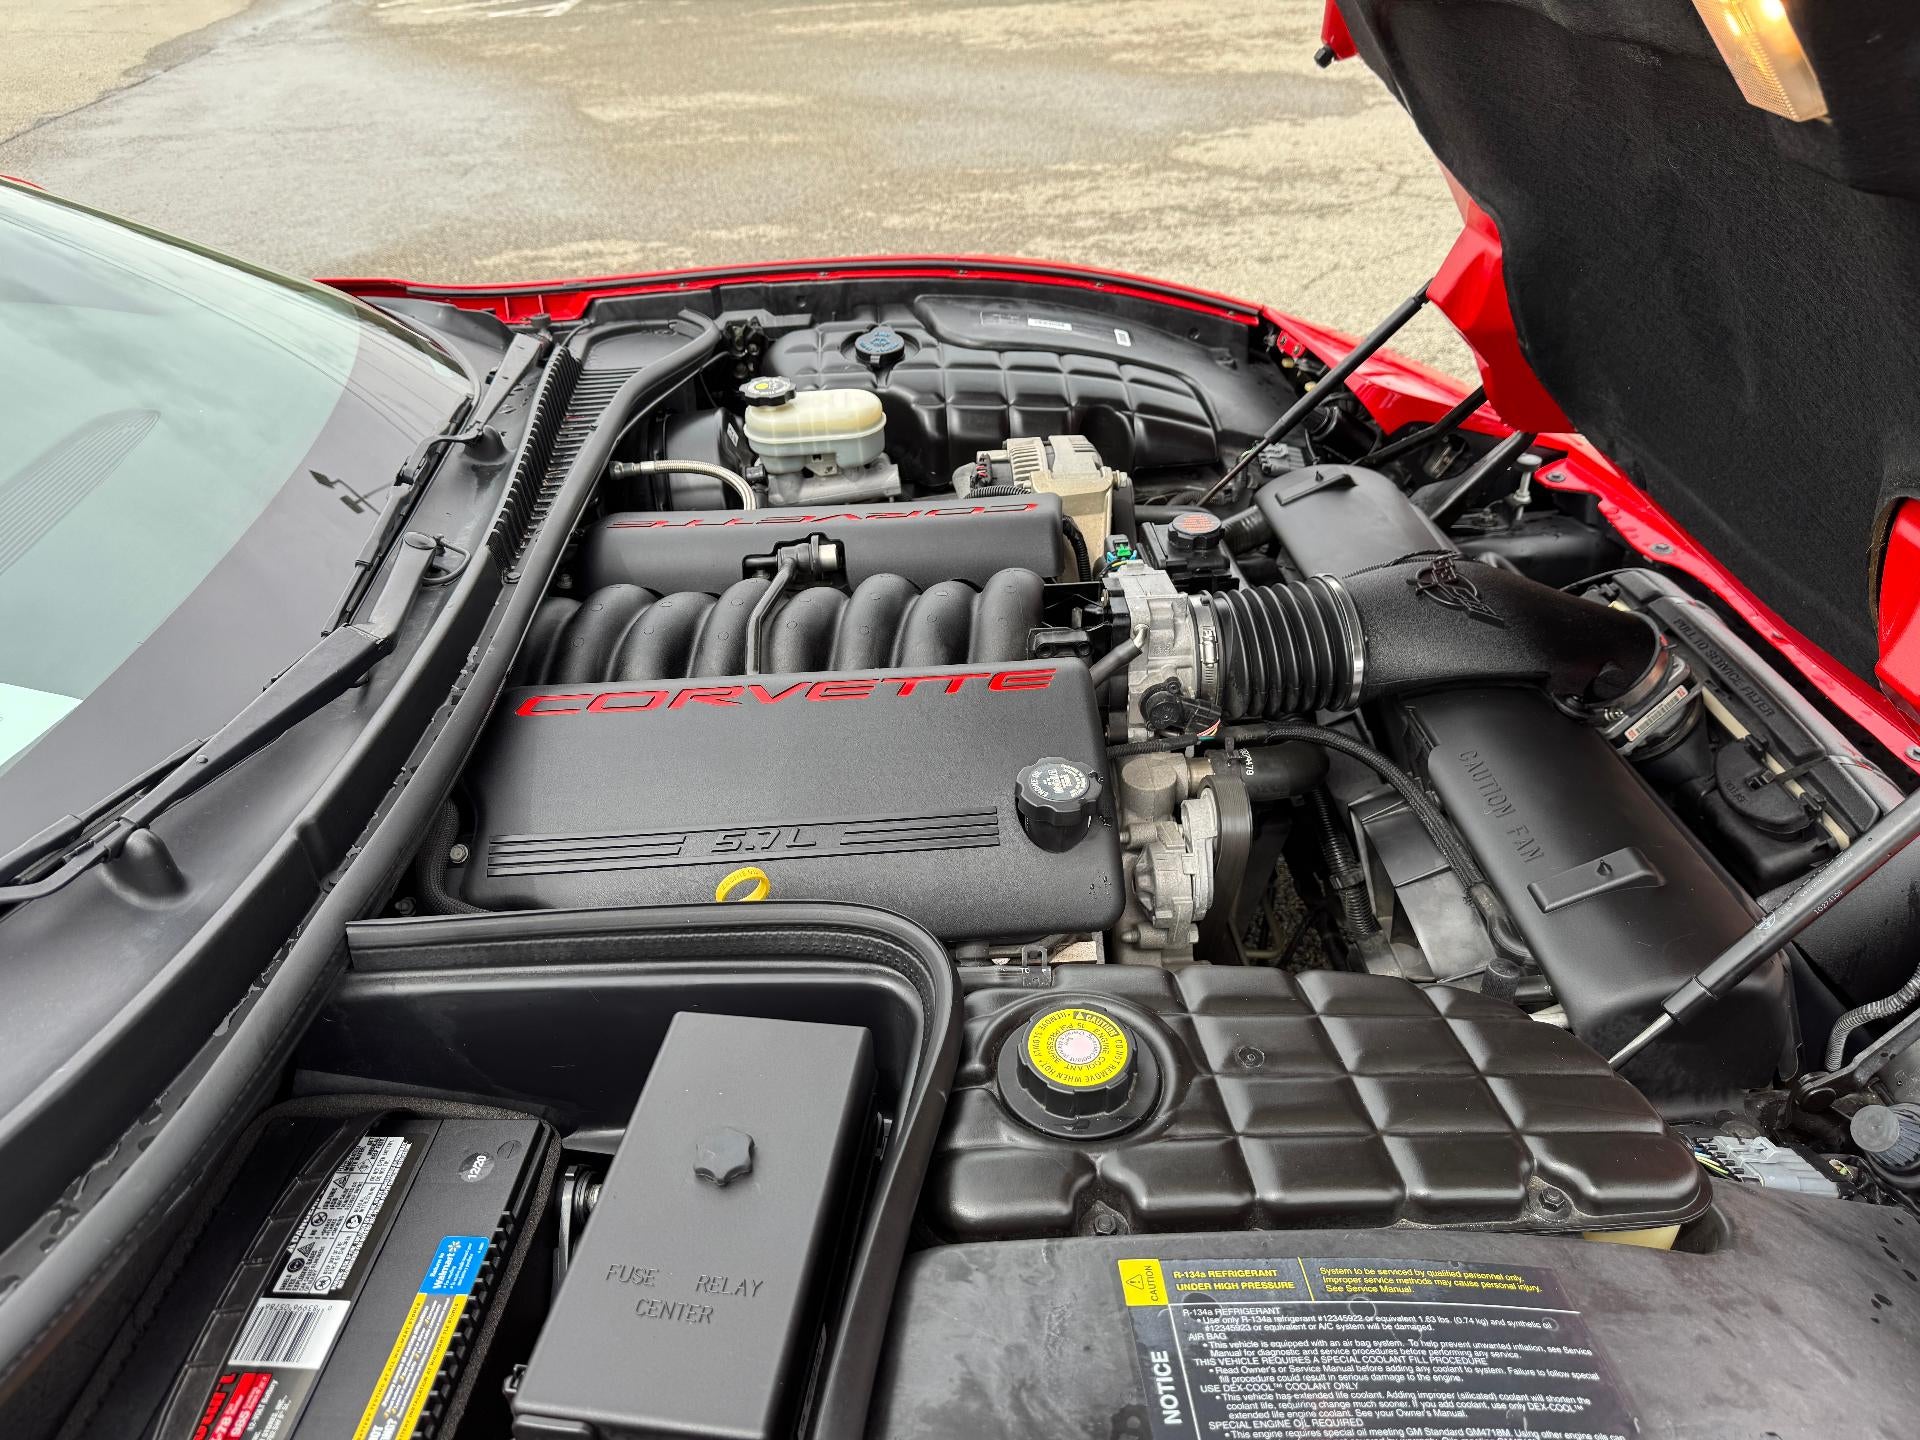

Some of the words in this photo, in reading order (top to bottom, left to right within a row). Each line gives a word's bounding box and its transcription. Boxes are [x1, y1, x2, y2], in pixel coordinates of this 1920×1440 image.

[606, 502, 1039, 529] CORVETTE
[1694, 637, 1708, 650] TO
[1706, 649, 1742, 687] SERVICE
[1741, 686, 1776, 717] FILTER
[515, 667, 1057, 717] CORVETTE
[1458, 750, 1517, 819] CAUTION
[1506, 824, 1545, 863] FAN
[710, 827, 818, 854] 5.7L
[1040, 1011, 1067, 1031] REMOVE
[1085, 1013, 1120, 1038] CAUTION
[1032, 1031, 1043, 1057] SLOWLY
[1093, 1028, 1110, 1055] ENGINE
[1115, 1039, 1124, 1049] DO
[1064, 1056, 1106, 1072] COOLANT
[1114, 1050, 1124, 1064] NOT
[1039, 1060, 1056, 1076] HOT
[1085, 1063, 1117, 1082] REMOVE
[1056, 1072, 1082, 1083] WHEN
[467, 1155, 487, 1180] 12/20
[432, 1252, 456, 1289] Walmart
[1173, 1270, 1206, 1278] R-134a
[1207, 1269, 1278, 1277] REFRIGERANT
[1320, 1268, 1353, 1276] System
[1413, 1270, 1426, 1278] by
[1426, 1270, 1462, 1278] qualified
[1462, 1272, 1504, 1280] personnel
[605, 1263, 660, 1288] FUSE
[695, 1273, 764, 1298] RELAY
[1144, 1265, 1158, 1302] CAUTION
[1176, 1282, 1212, 1290] UNDER
[1240, 1281, 1295, 1289] PRESSURE
[1323, 1277, 1362, 1285] Improper
[1433, 1279, 1453, 1287] may
[1480, 1282, 1517, 1290] personal
[1345, 1284, 1378, 1292] Service
[635, 1298, 715, 1325] CENTER
[1182, 1308, 1213, 1316] R-134a
[1213, 1307, 1282, 1315] REFRIGERANT
[1202, 1316, 1220, 1324] Use
[1220, 1317, 1240, 1325] only
[1272, 1316, 1317, 1324] refrigerant
[1374, 1316, 1417, 1324] equivalent
[1489, 1318, 1506, 1326] and
[1506, 1320, 1541, 1328] synthetic
[1262, 1324, 1307, 1332] equivalent
[1317, 1322, 1334, 1330] A/C
[1334, 1323, 1366, 1331] system
[1366, 1322, 1380, 1330] will
[1380, 1322, 1393, 1330] be
[1393, 1324, 1434, 1332] damaged.
[1187, 1332, 1205, 1340] AIR
[1242, 1348, 1256, 1356] for
[1256, 1349, 1300, 1357] diagnostic
[1301, 1347, 1319, 1355] and
[1350, 1348, 1399, 1356] procedures
[1399, 1347, 1427, 1355] before
[1427, 1349, 1473, 1357] performing
[1473, 1350, 1489, 1358] any
[1217, 1357, 1260, 1365] VEHICLE
[1260, 1356, 1312, 1364] REQUIRES
[1320, 1355, 1361, 1363] SPECIAL
[1361, 1355, 1408, 1363] COOLANT
[1408, 1355, 1428, 1363] FILL
[1428, 1356, 1487, 1364] PROCEDURE
[1229, 1375, 1275, 1383] procedure
[1301, 1373, 1327, 1381] result
[1369, 1374, 1406, 1382] damage
[1416, 1373, 1431, 1381] the
[1431, 1374, 1464, 1382] engine.
[1151, 1351, 1183, 1425] NOTICE
[1200, 1384, 1221, 1392] USE
[1284, 1382, 1332, 1390] COOLANT
[1225, 1402, 1259, 1410] coolant
[1277, 1402, 1317, 1410] requiring
[1317, 1401, 1351, 1409] change
[1351, 1399, 1377, 1407] much
[1411, 1399, 1419, 1407] If
[1419, 1401, 1437, 1409] you
[1436, 1400, 1455, 1408] add
[1507, 1402, 1526, 1410] only
[1270, 1410, 1285, 1418] life
[1285, 1411, 1317, 1419] engine
[1317, 1409, 1353, 1417] coolant.
[1354, 1408, 1373, 1416] See
[1374, 1410, 1394, 1418] your
[1395, 1408, 1432, 1416] Owner's
[1432, 1409, 1467, 1417] Manual.
[1208, 1420, 1251, 1429] SPECIAL
[1251, 1419, 1292, 1428] ENGINE
[1292, 1418, 1310, 1427] OIL
[1310, 1418, 1364, 1426] REQUIRED
